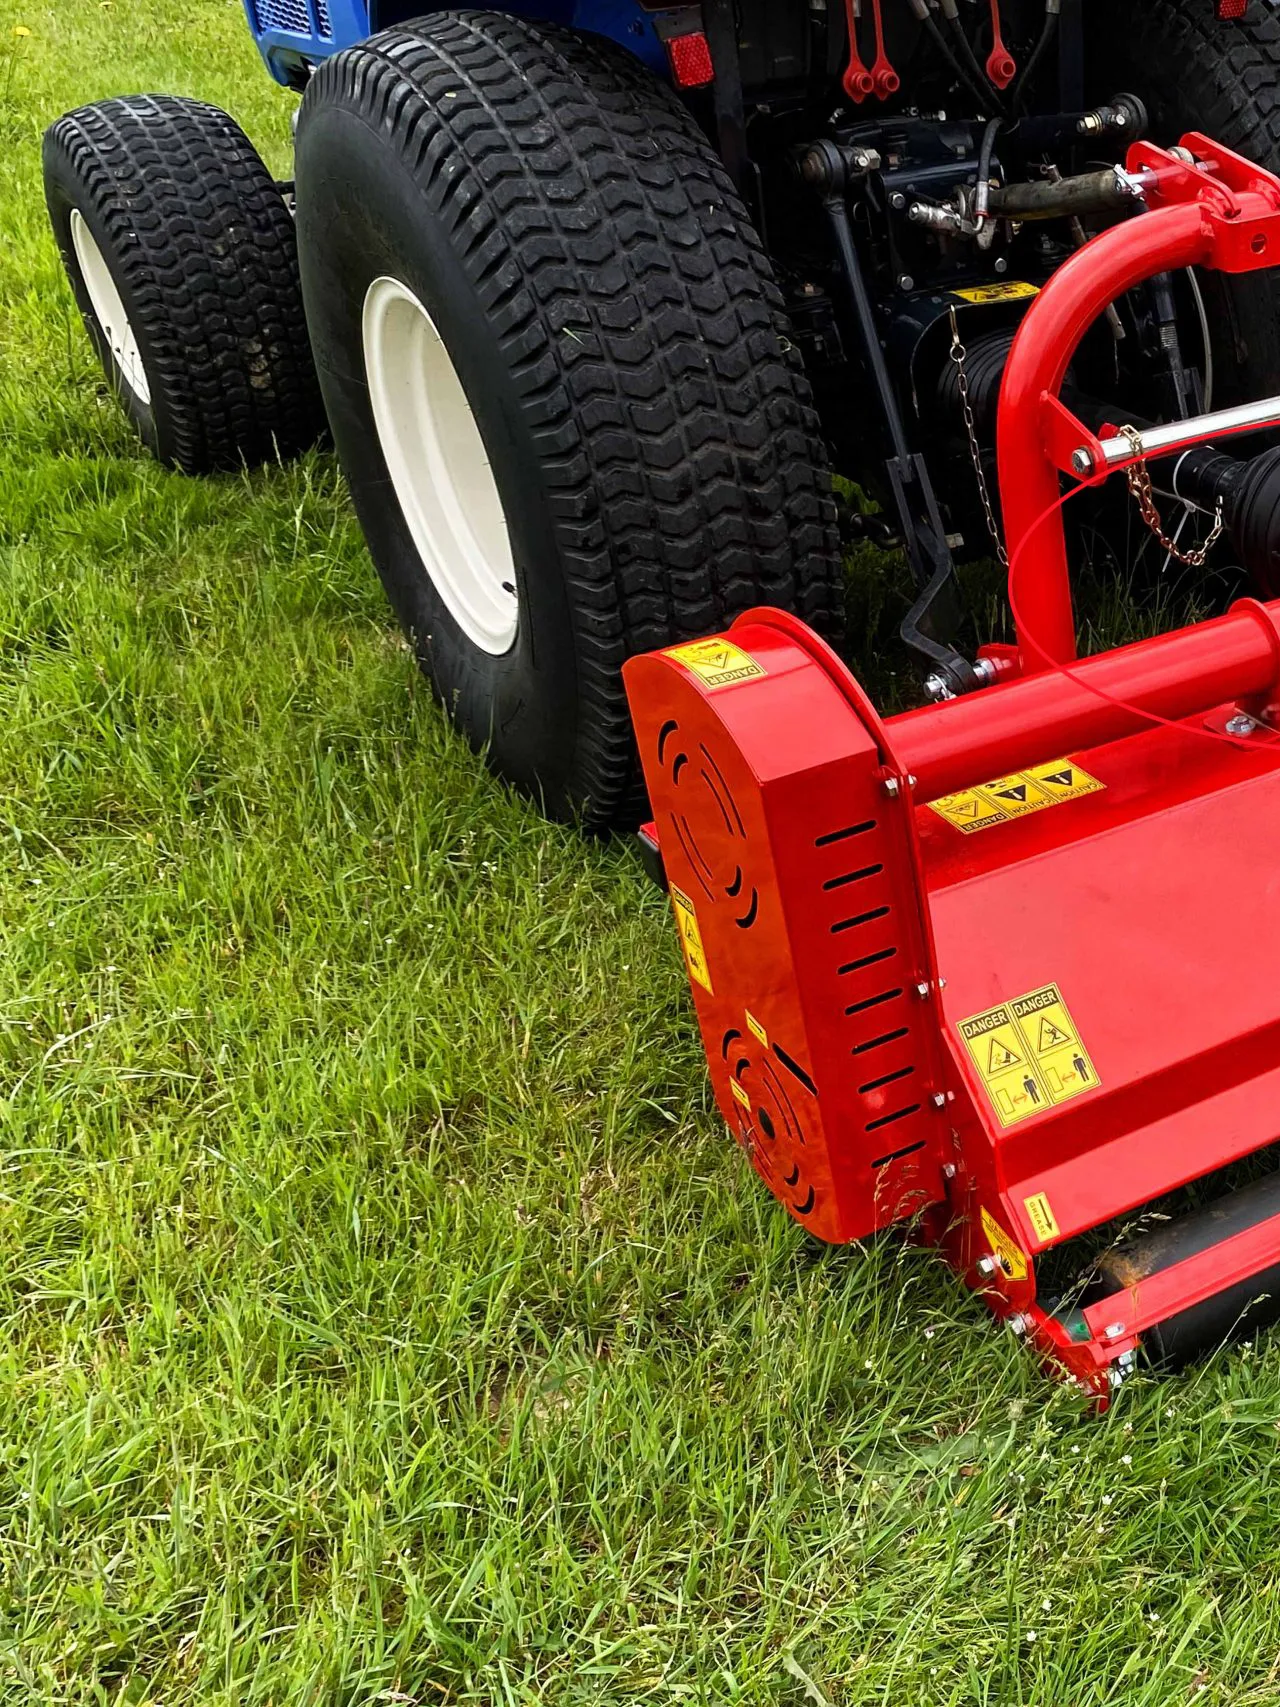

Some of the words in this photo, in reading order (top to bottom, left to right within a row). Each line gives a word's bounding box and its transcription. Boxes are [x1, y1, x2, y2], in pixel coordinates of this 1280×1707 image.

[709, 666, 759, 685] DANGER
[1060, 782, 1097, 799] CAUTION
[1012, 798, 1052, 815] CAUTION
[964, 813, 1005, 831] DANGER
[1014, 991, 1057, 1016] DANGER
[963, 1012, 1007, 1037] DANGER
